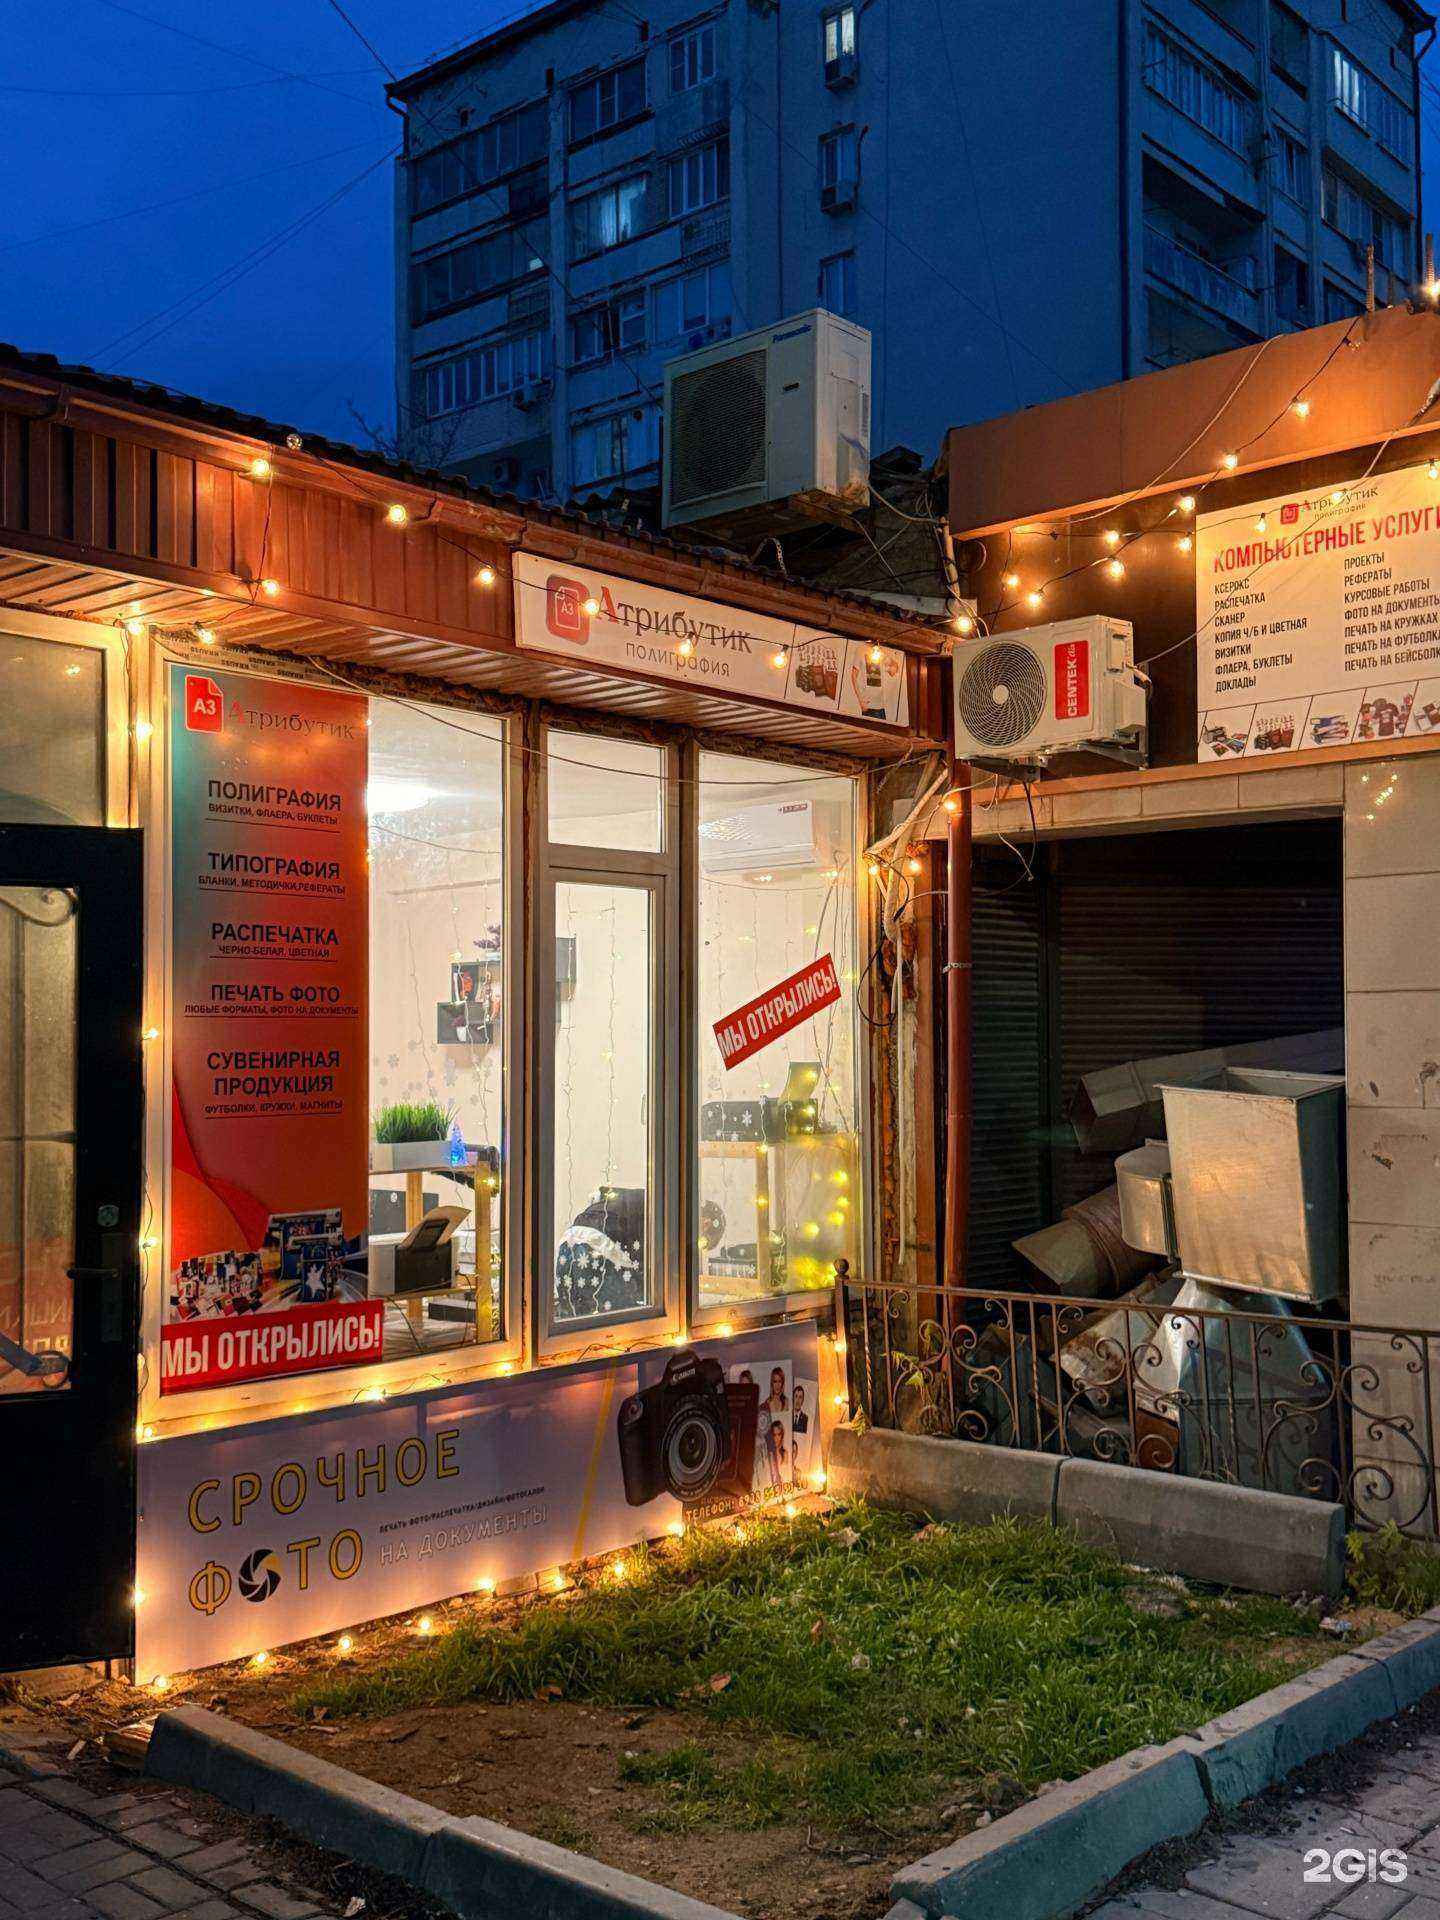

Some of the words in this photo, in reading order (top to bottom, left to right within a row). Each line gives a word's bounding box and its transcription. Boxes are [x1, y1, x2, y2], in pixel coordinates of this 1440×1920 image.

[1214, 522, 1366, 574] КОМПЬЮТЕРНЫЕ
[1344, 552, 1385, 570] ПРОЕКТЫ
[1214, 578, 1250, 595] КСЕРОКС
[1344, 568, 1392, 587] РЕФЕРАТЫ
[1214, 593, 1266, 611] РАСПЕЧАТКА
[1344, 585, 1391, 604] КУРСОВЫЕ
[1393, 578, 1430, 595] РАБОТЫ
[595, 585, 752, 655] Атрибутик
[1214, 612, 1246, 628] СКАНЕР
[1344, 606, 1369, 620] ФОТО
[1371, 604, 1383, 616] НА
[1214, 629, 1242, 644] КОПИЯ
[1243, 626, 1259, 639] Ч/Б
[1261, 624, 1268, 636] И
[1269, 617, 1307, 635] ЦВЕТНАЯ
[1344, 622, 1378, 638] ПЕЧАТЬ
[1380, 620, 1392, 632] НА
[1394, 612, 1438, 630] КРУЖКАХ
[1215, 644, 1251, 660] ВИЗИТКИ
[1344, 640, 1378, 655] ПЕЧАТЬ
[1380, 636, 1392, 649] НА
[625, 641, 731, 678] полиграфия
[1215, 660, 1251, 676] ФЛАЕРА,
[1253, 653, 1293, 670] БУКЛЕТЫ
[1344, 657, 1378, 672] ПЕЧАТЬ
[1380, 654, 1392, 667] НА
[1067, 657, 1078, 716] CENTEK
[1215, 675, 1256, 694] ДОКЛАДЫ
[227, 700, 355, 741] Атрибутик
[208, 780, 342, 811] ПОЛИГРАФИЯ
[208, 803, 254, 818] ВИЗИТКИ,
[256, 808, 296, 821] ФЛАЕРА,
[297, 812, 339, 826] БУКЛЕТЫ
[208, 852, 341, 880] ТИПОГРАФИЯ
[211, 922, 340, 946] РАСПЕЧАТКА
[288, 948, 330, 958] ЦВЕТНАЯ
[211, 984, 285, 1003] ПЕЧАТЬ
[290, 986, 341, 1004] ФОТО
[184, 1004, 220, 1015] ЛЮБЫЕ
[270, 1006, 295, 1016] ФОТО
[716, 1019, 748, 1060] МЫ
[746, 963, 838, 1041] ОТКРЫЛИСЬ!
[207, 1050, 341, 1071] СУВЕНИРНАЯ
[214, 1075, 334, 1097] ПРОДУКЦИЯ
[300, 1100, 343, 1112] МАГНИТЫ
[161, 1334, 209, 1379] МЫ
[217, 1312, 382, 1372] ОТКРЫЛИСЬ!
[672, 1368, 696, 1383] Canon
[187, 1428, 461, 1534] СРОЧНОЕ
[379, 1540, 409, 1566] НА
[418, 1504, 548, 1561] ДОКУМЕНТЫ
